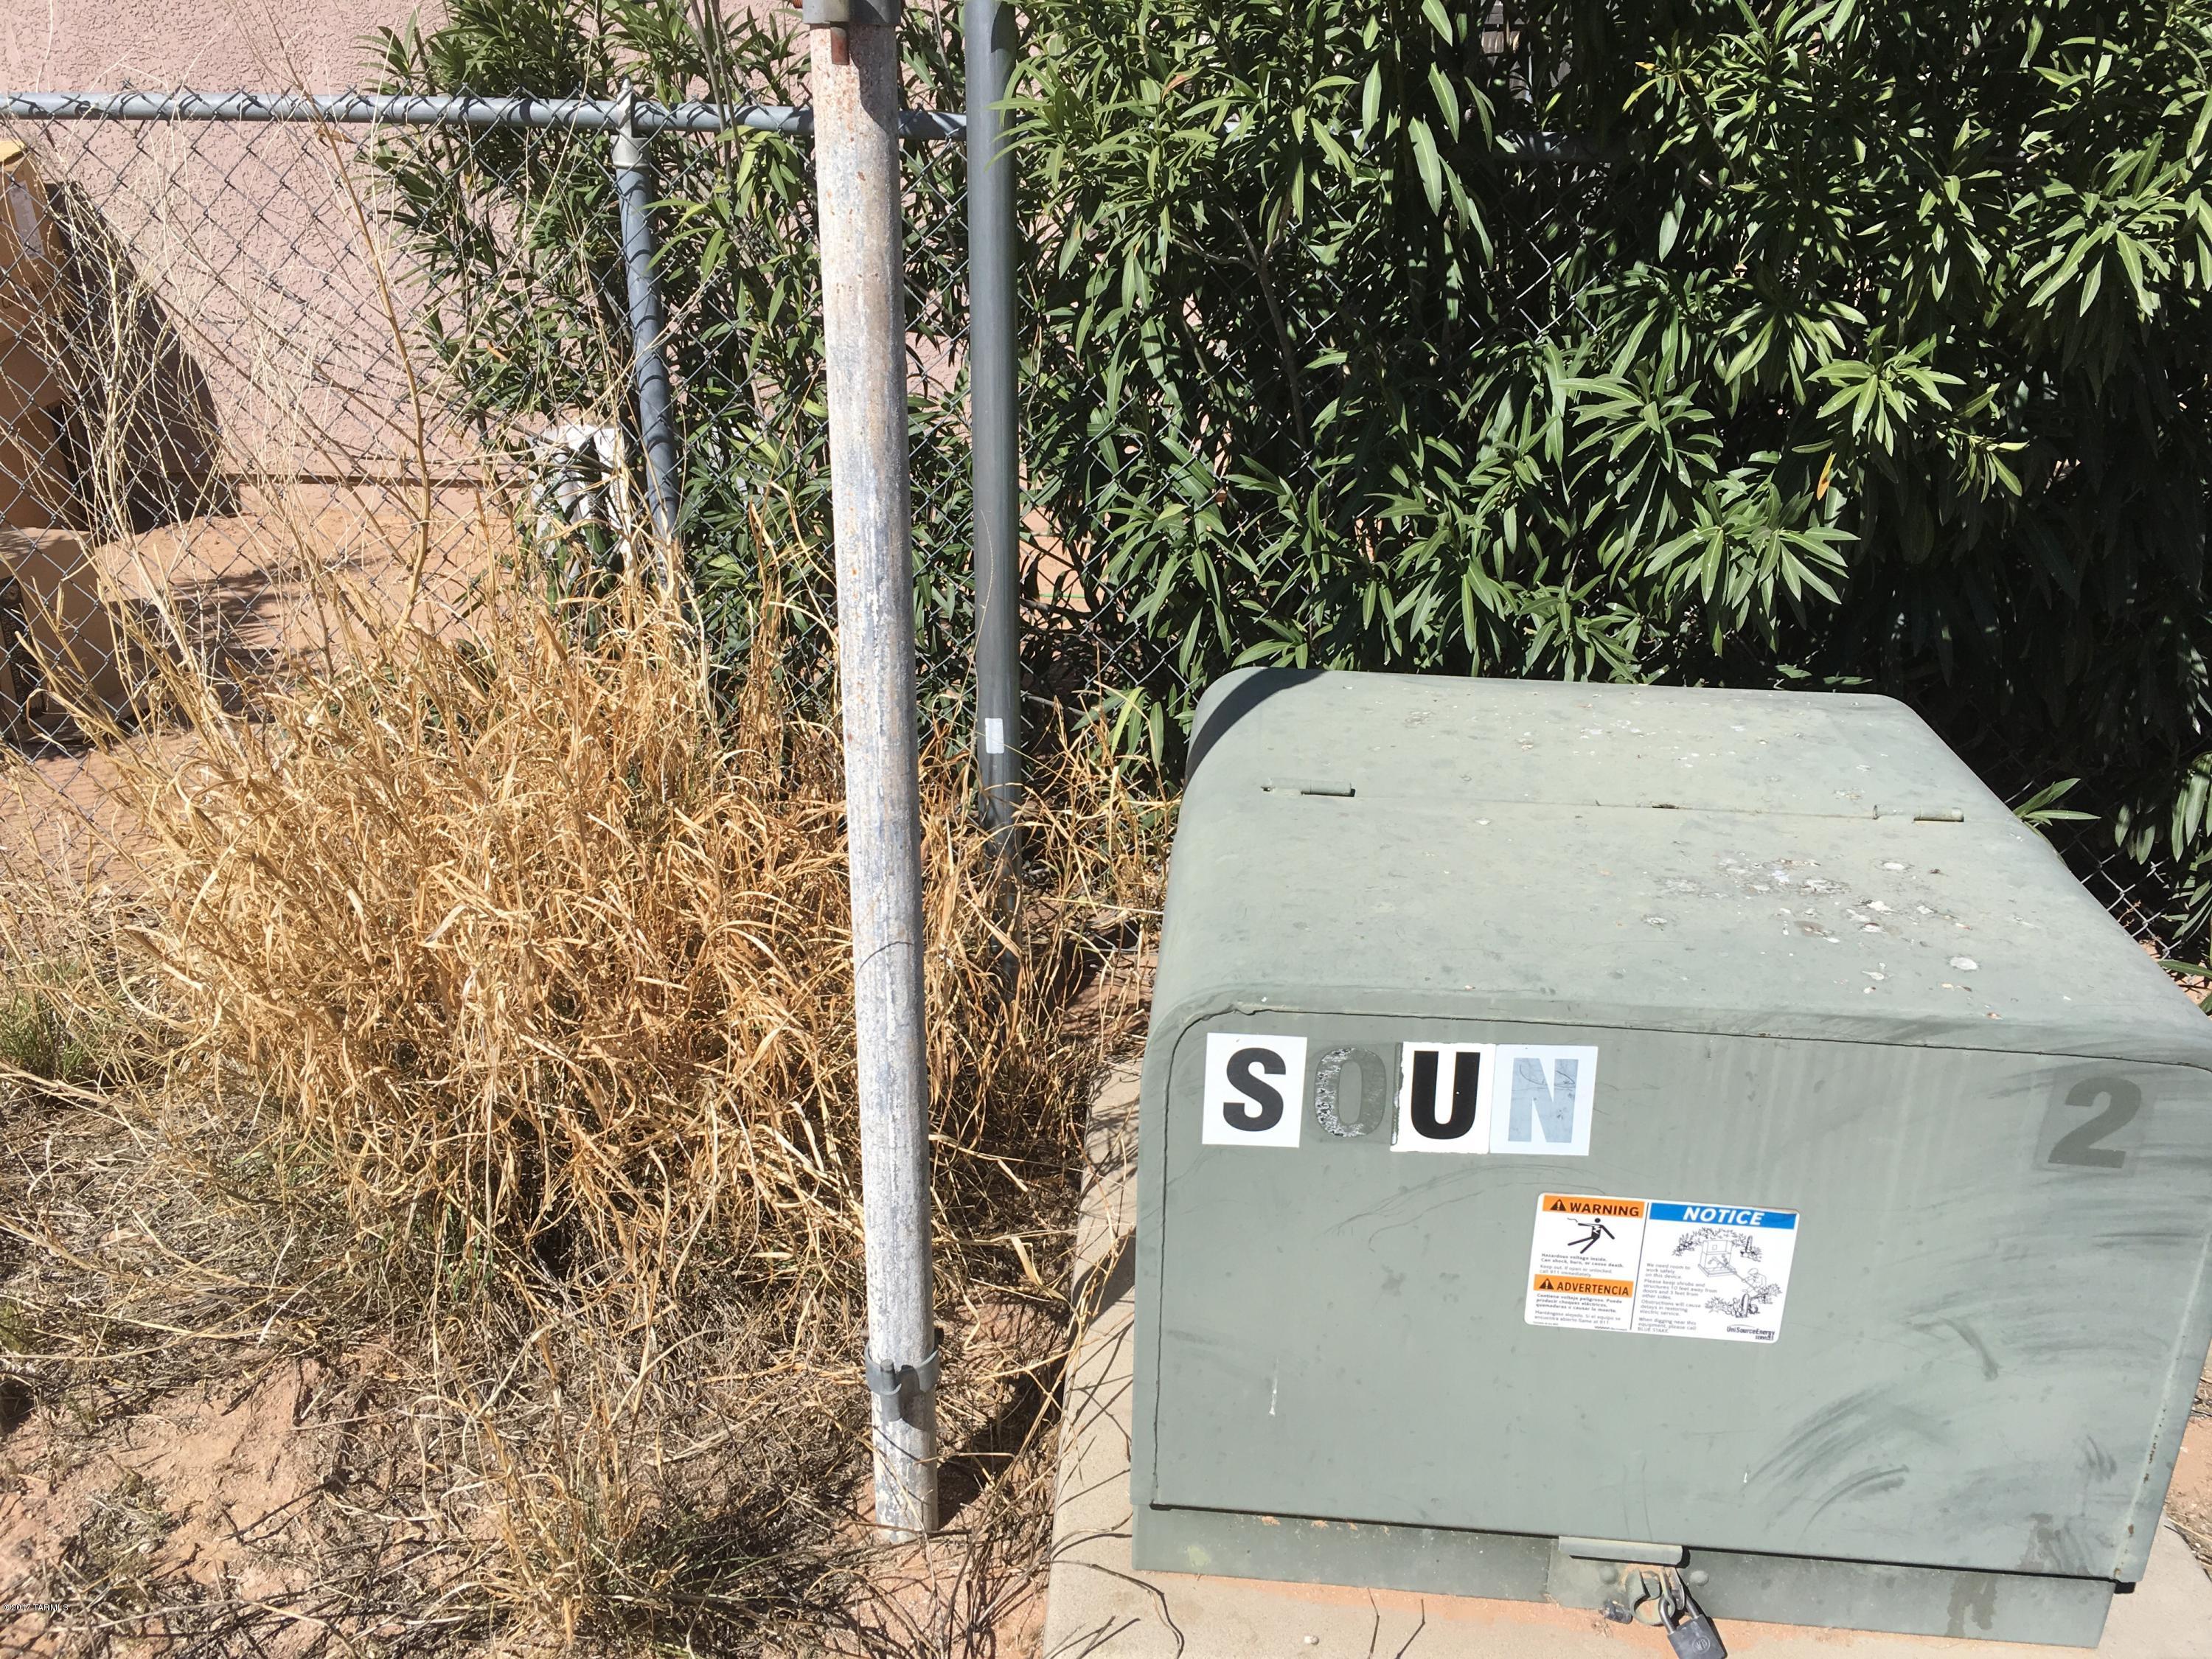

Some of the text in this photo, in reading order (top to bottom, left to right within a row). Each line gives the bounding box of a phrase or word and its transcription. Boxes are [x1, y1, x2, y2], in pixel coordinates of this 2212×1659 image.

[2048, 1077, 2141, 1169] 2
[1570, 1202, 1639, 1217] WARNING
[1683, 1206, 1765, 1226] NOTICE
[1557, 1281, 1629, 1295] ADVERTENCIA
